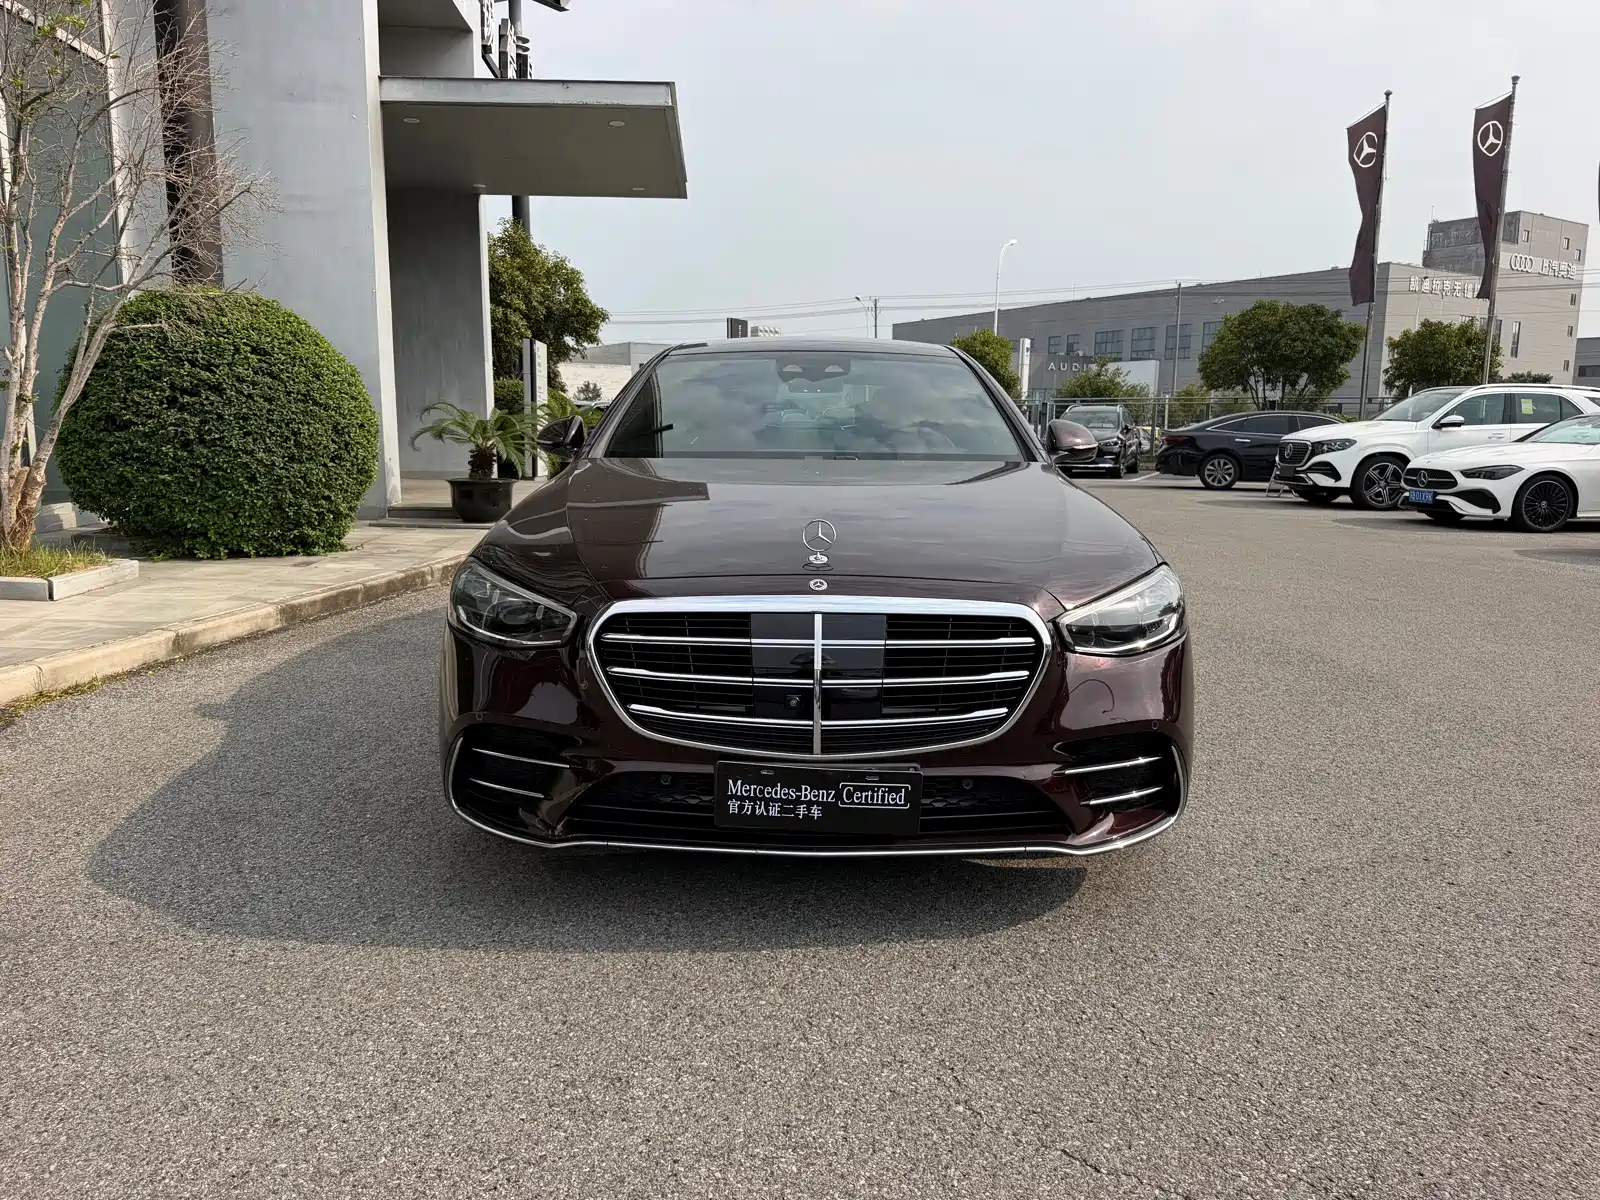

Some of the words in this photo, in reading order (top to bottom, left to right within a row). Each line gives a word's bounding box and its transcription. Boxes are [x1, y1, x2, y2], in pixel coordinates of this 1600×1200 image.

[1538, 259, 1577, 280] 上汽奥迪
[1047, 362, 1087, 372] AUDI
[727, 779, 836, 802] Mercedes-Benz
[843, 786, 906, 805] Certified
[727, 799, 823, 820] 官方认证二手车
